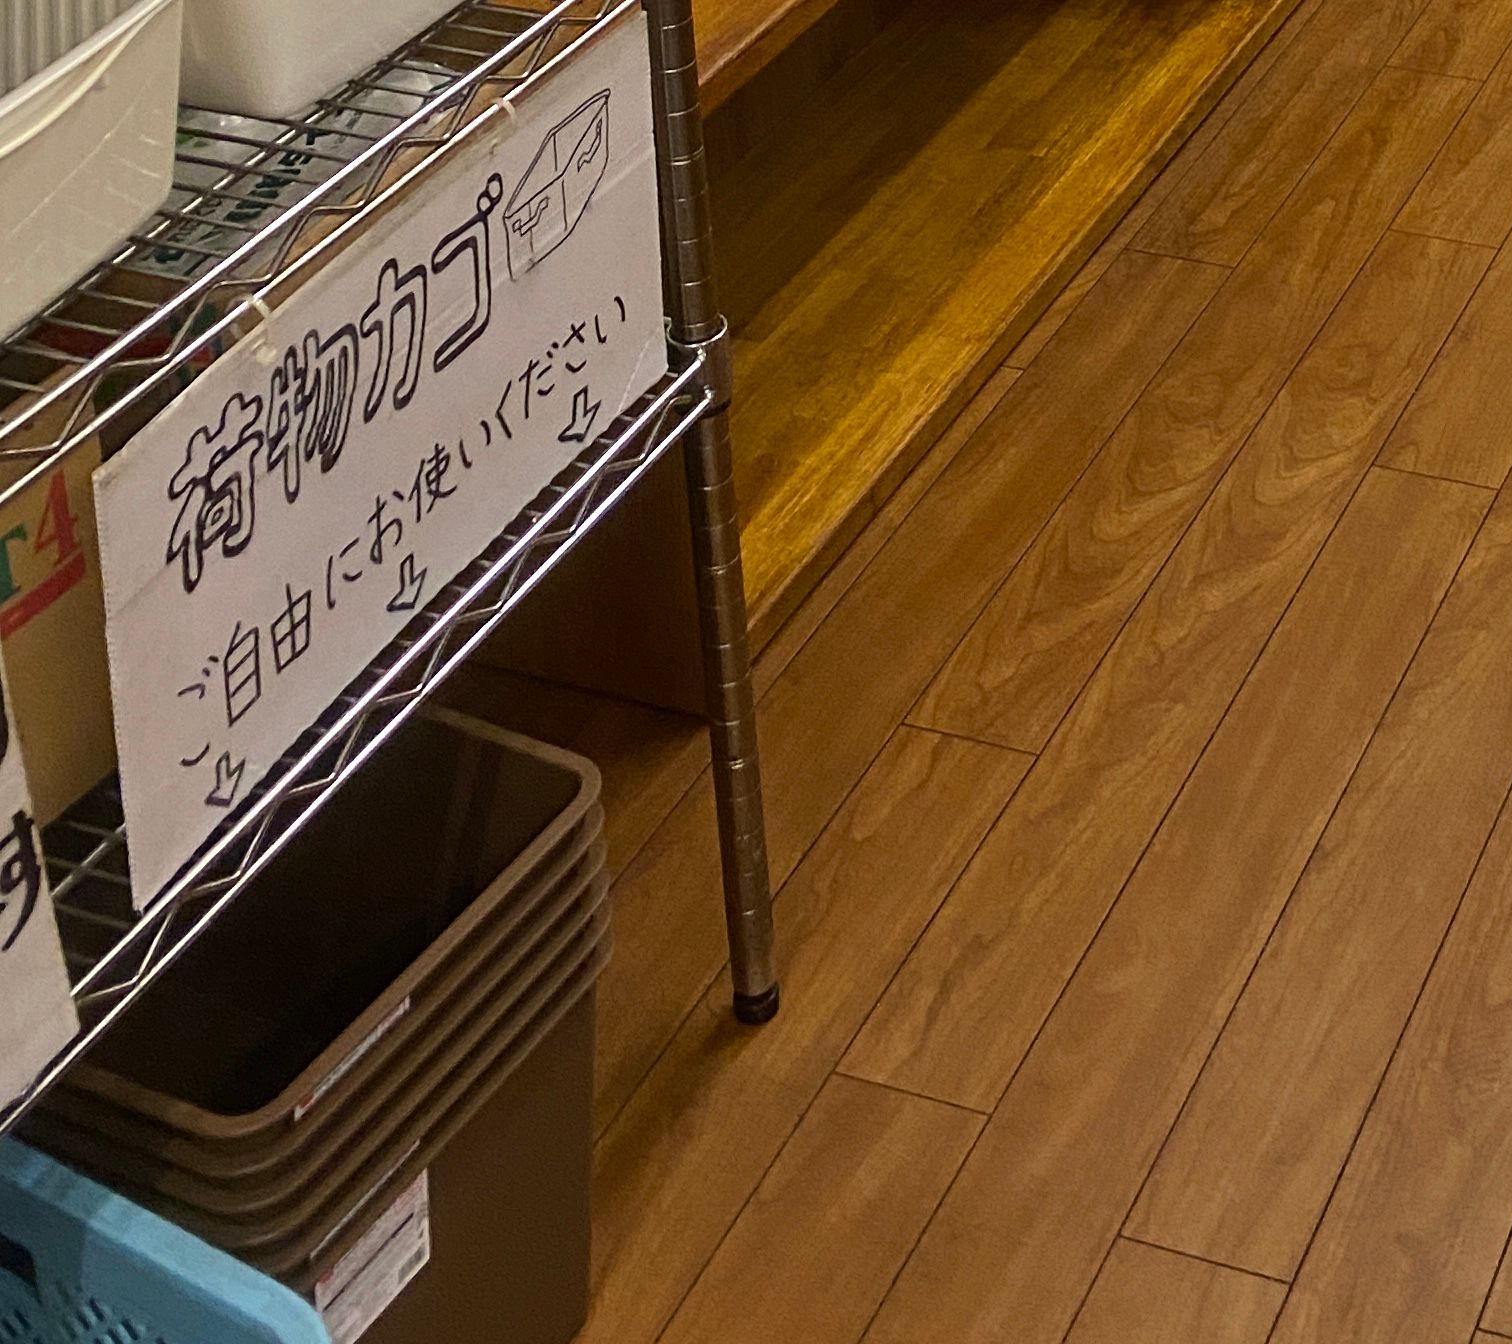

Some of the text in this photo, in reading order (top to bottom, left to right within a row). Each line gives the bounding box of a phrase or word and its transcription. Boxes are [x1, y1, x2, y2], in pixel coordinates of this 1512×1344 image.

[167, 172, 504, 594] 荷物カゴ
[177, 296, 627, 767] ご自由にお使いください
